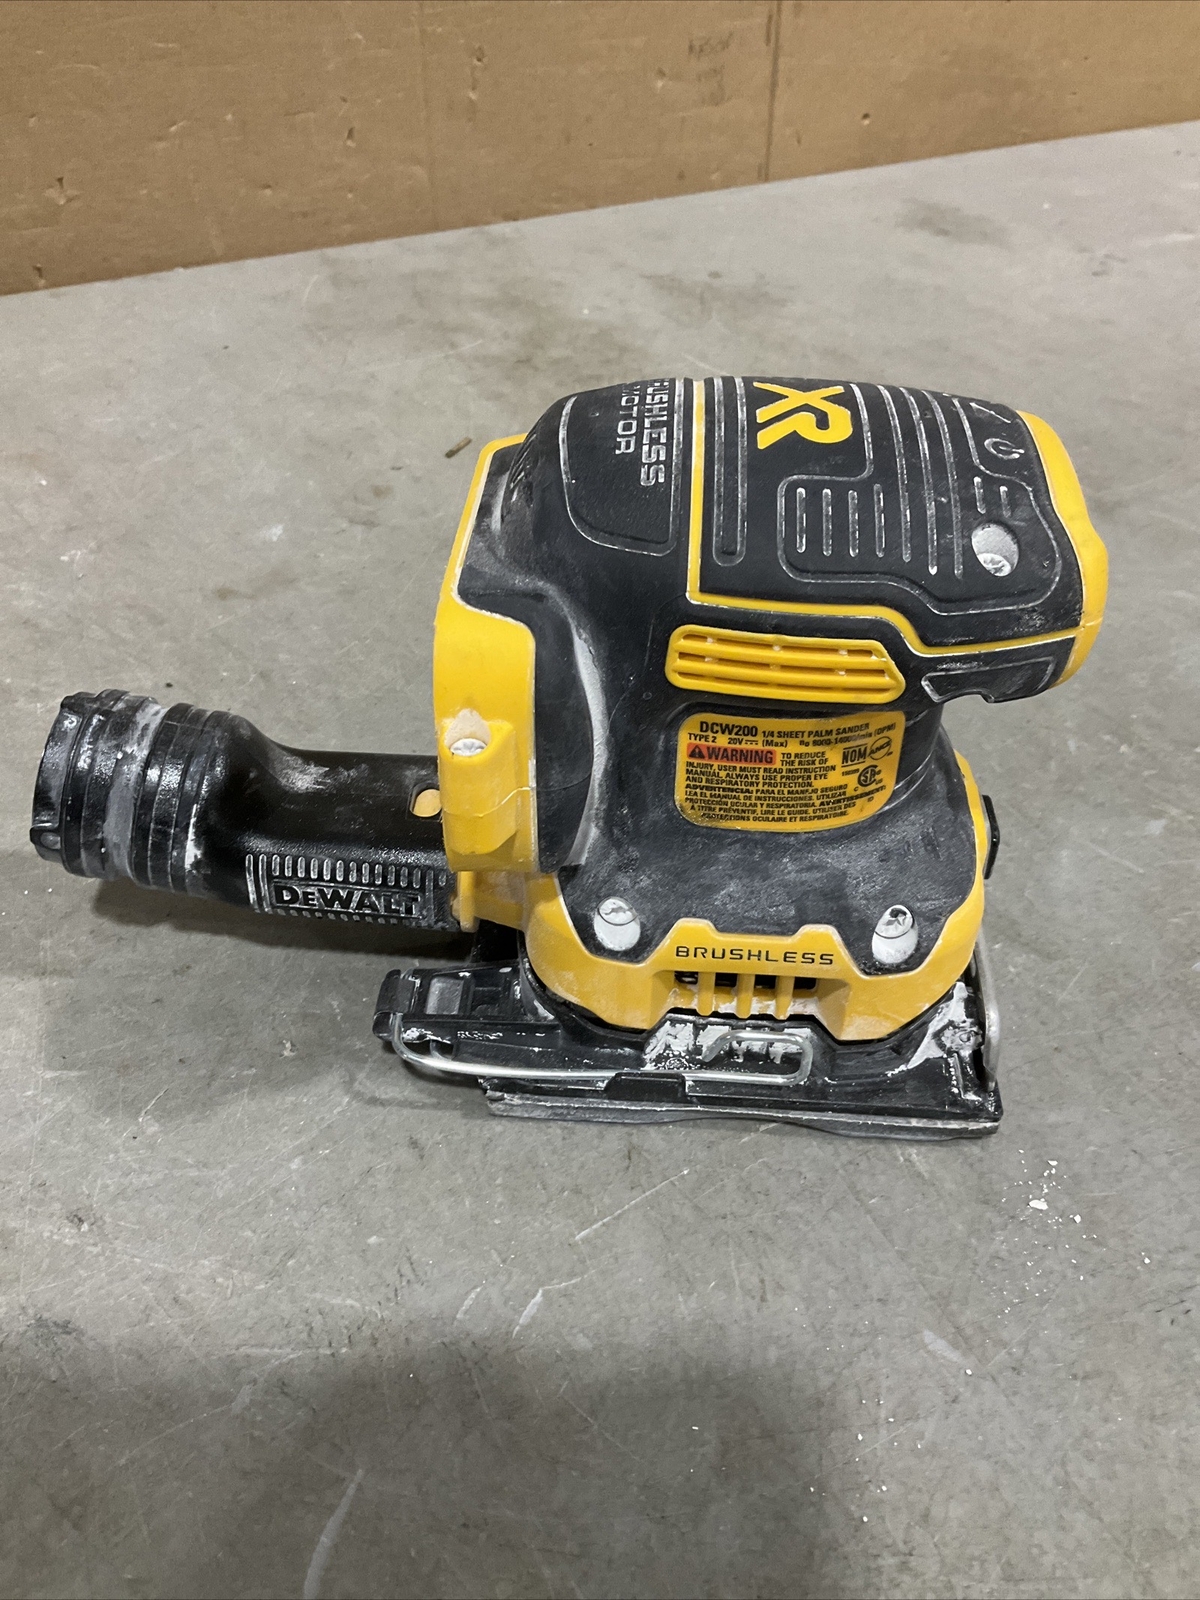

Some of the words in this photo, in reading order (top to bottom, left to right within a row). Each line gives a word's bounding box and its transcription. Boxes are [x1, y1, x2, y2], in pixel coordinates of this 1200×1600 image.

[753, 381, 853, 449] XR
[700, 721, 758, 737] DCW200
[808, 729, 833, 738] PALM
[835, 722, 870, 735] SANDER
[688, 732, 710, 742] TYPE
[728, 737, 744, 746] 20V
[762, 739, 788, 748] (Max)
[706, 746, 774, 764] WARNING
[794, 751, 826, 759] REDUCE
[842, 746, 868, 764] NOM
[686, 761, 715, 771] INJURY,
[739, 766, 762, 774] MUST
[785, 765, 836, 774] INSTRUCTION
[780, 759, 795, 767] THE
[797, 759, 816, 767] RISK
[686, 776, 703, 784] AND
[705, 777, 760, 788] RESPIRATORY
[820, 784, 848, 793] SEGURO
[710, 792, 741, 801] MANUAL
[844, 801, 857, 809] DES
[273, 885, 420, 914] DEWALT
[676, 945, 834, 966] BRUSHLESS
